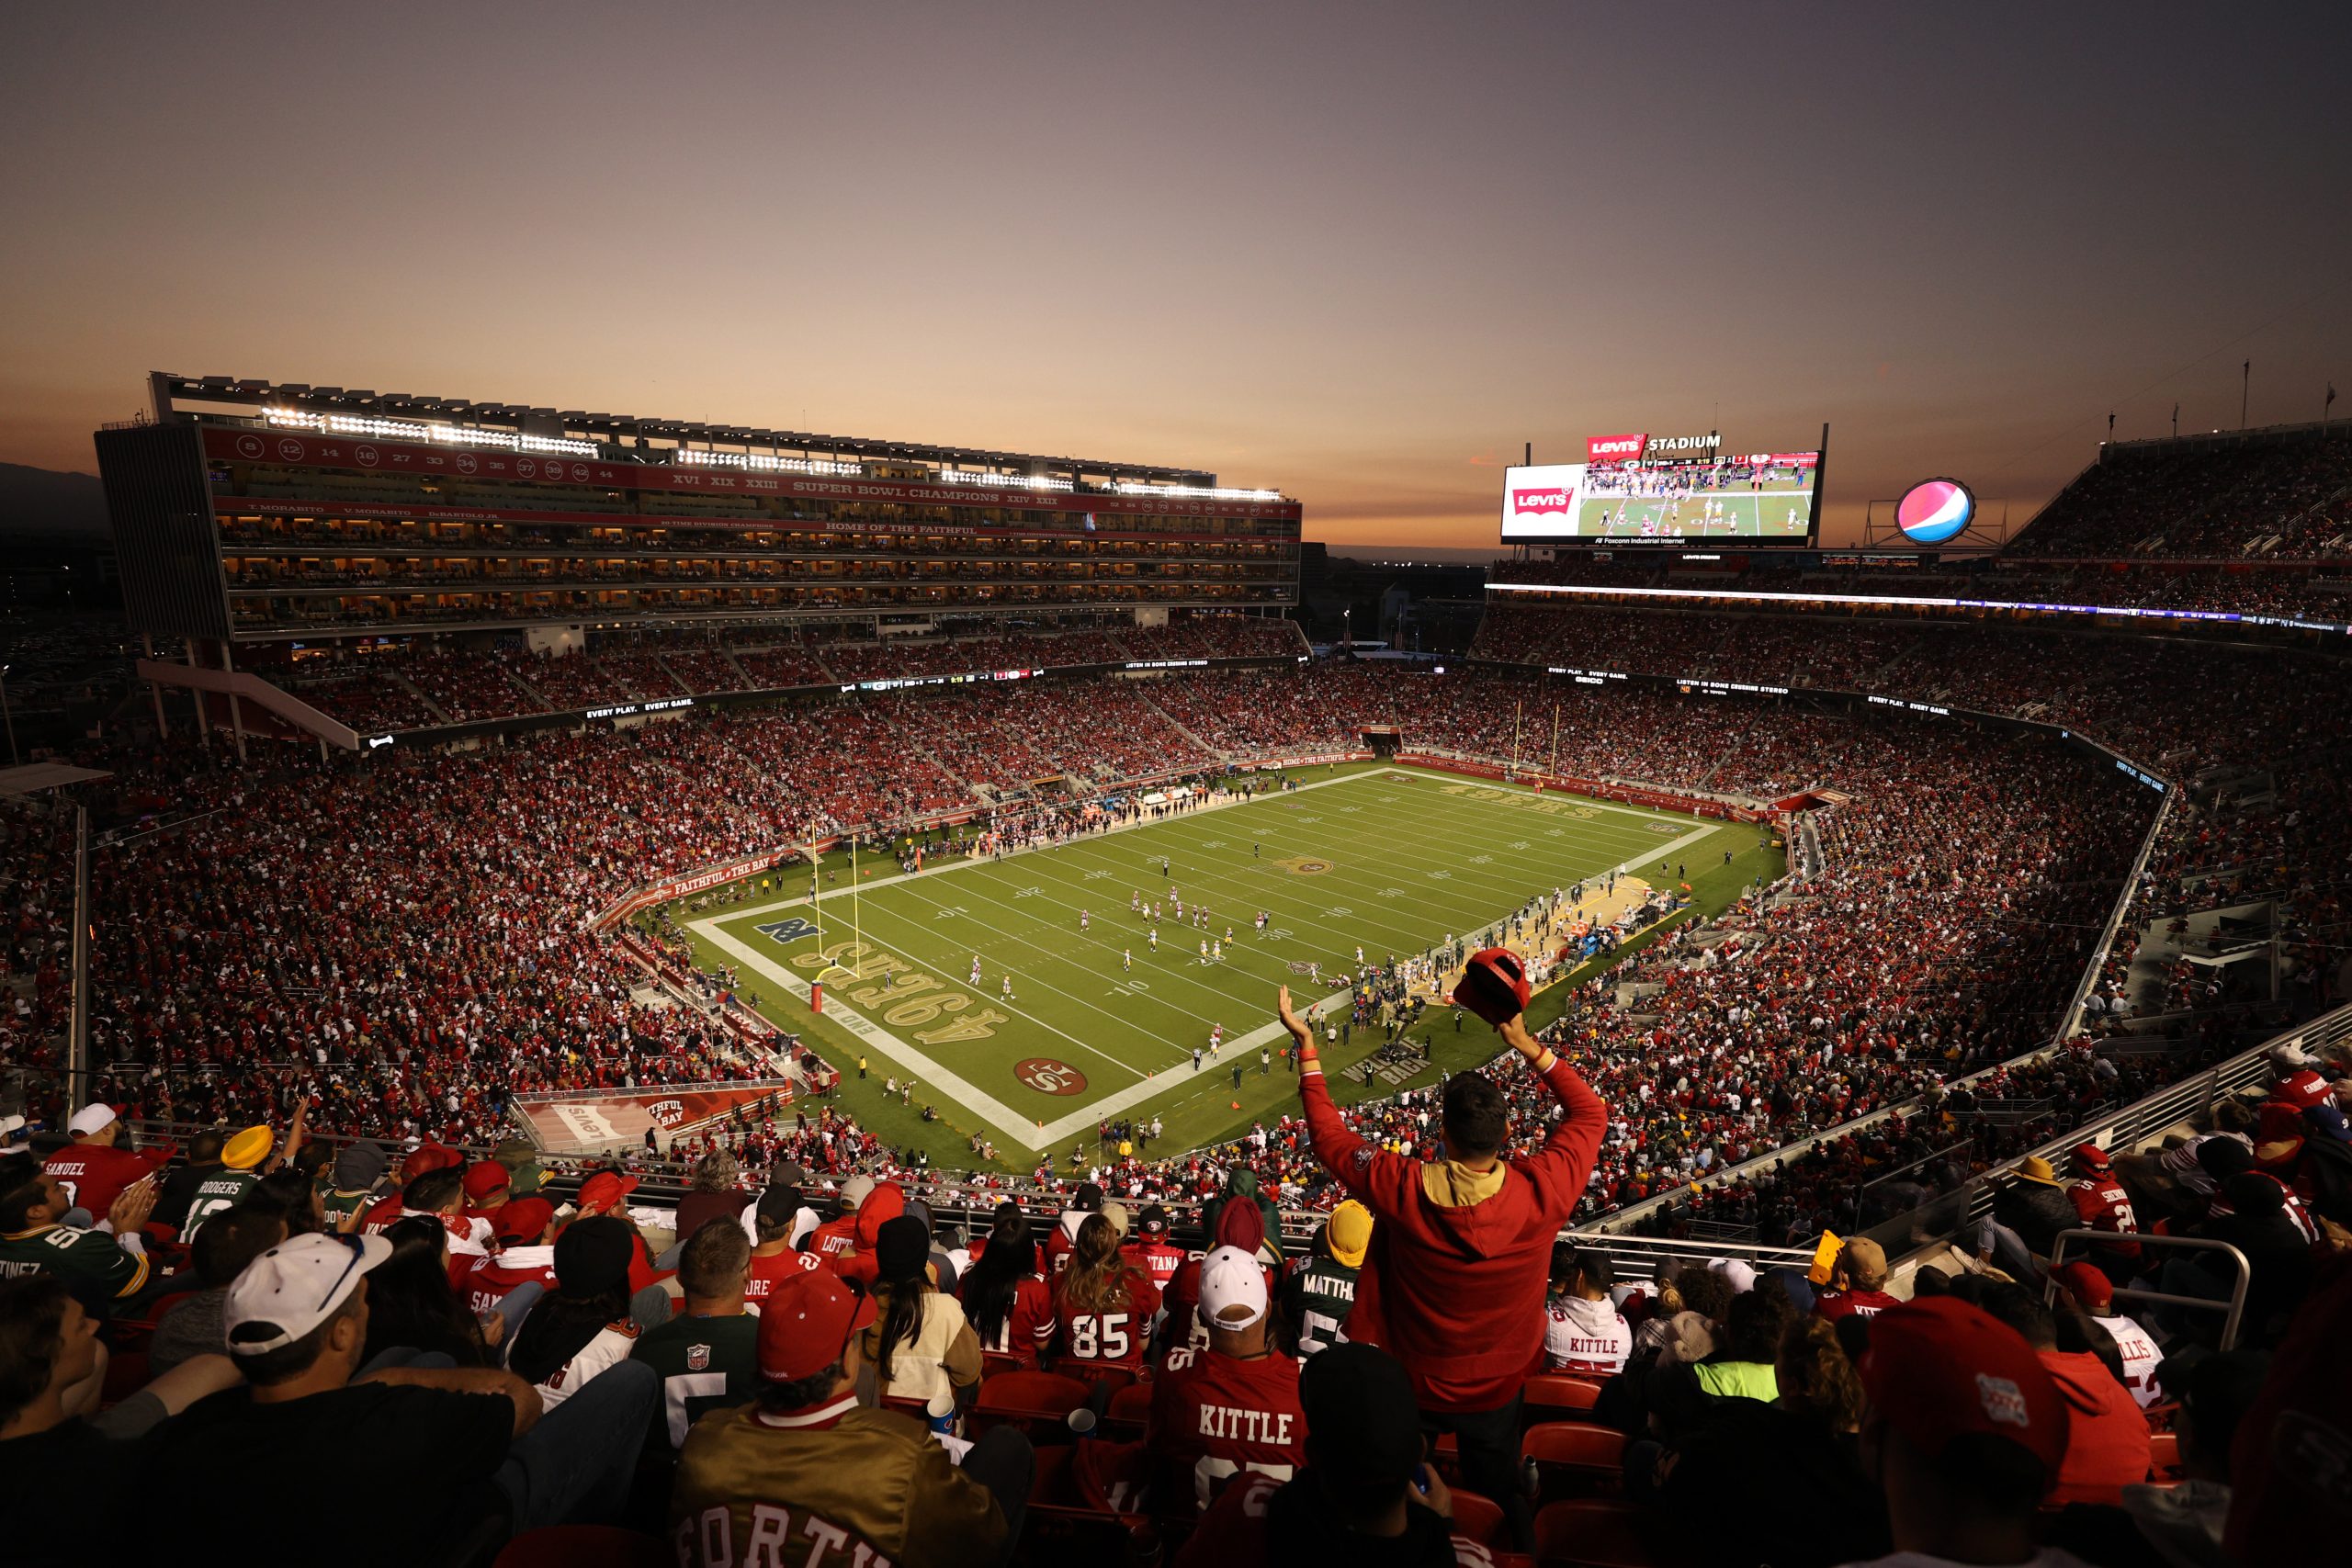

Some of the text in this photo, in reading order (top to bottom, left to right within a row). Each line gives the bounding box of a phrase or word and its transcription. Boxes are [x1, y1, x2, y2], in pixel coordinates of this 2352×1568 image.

[1649, 435, 1721, 450] STADIUM
[322, 448, 339, 457] 14
[392, 454, 411, 462] 27
[426, 457, 444, 465] 33
[599, 470, 614, 479] 44
[673, 474, 1058, 505] XVI XIX XXIII SUPER BOWL CHAMPIONS XXIV XXIX
[826, 523, 977, 535] HOME OF THE FAITHFUL
[1575, 676, 1603, 684] GEICO
[1760, 686, 1789, 694] STEREO
[587, 698, 694, 718] EVERY PLAY. EVERY GAME.
[1868, 695, 1950, 716] EVERY PLAY. EVERY GAME.
[1283, 754, 1346, 766] HOME THE FAITHFUL
[1439, 784, 1604, 819] 49ERS
[674, 868, 725, 895] FAITHFUL
[731, 863, 751, 877] THE
[752, 857, 770, 872] BAY
[788, 942, 1010, 1045] 49ERS
[1113, 980, 1150, 996] 10
[840, 1013, 876, 1036] END
[1379, 1055, 1433, 1086] BACK
[645, 1100, 683, 1115] ITHFUL
[661, 1111, 684, 1126] BAY
[45, 1162, 85, 1176] SAMUEL
[198, 1181, 242, 1195] RODGERS
[1586, 1201, 1594, 1211] 12
[821, 1235, 853, 1253] LOTT
[745, 1280, 770, 1296] ORE
[1303, 1273, 1354, 1303] MATTH
[1072, 1314, 1128, 1359] 85
[1570, 1338, 1619, 1355] KITTLE
[2117, 1340, 2151, 1361] ILLIS
[1199, 1404, 1293, 1446] KITTLE
